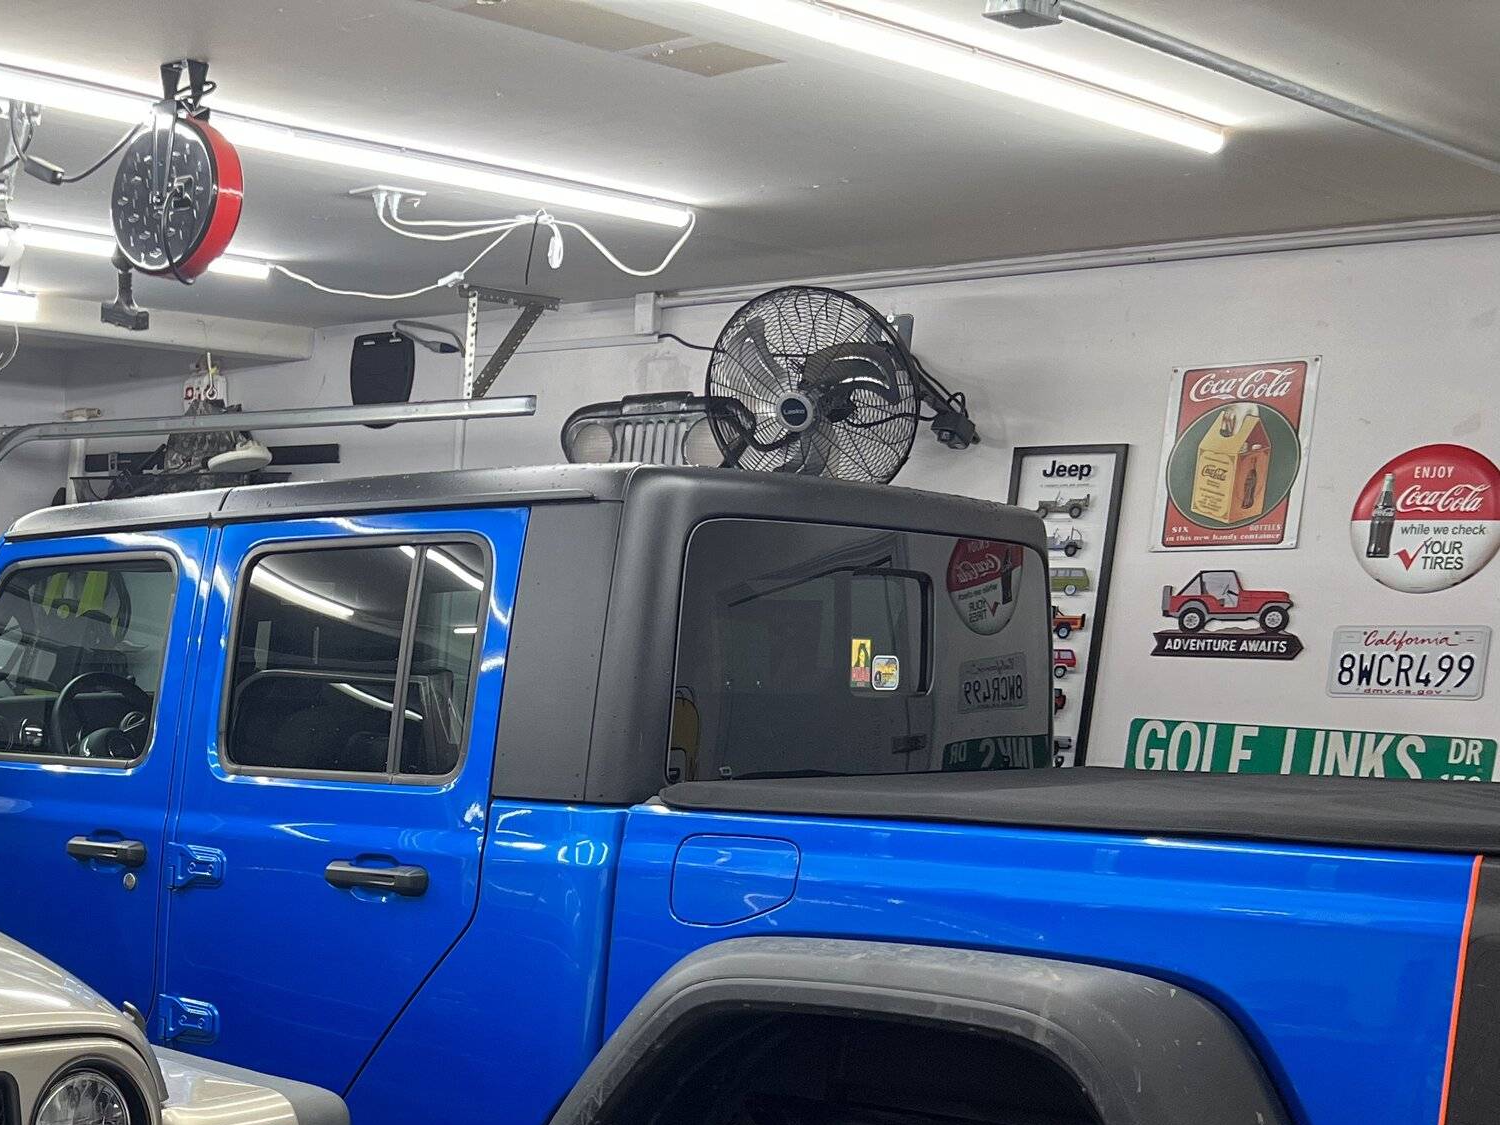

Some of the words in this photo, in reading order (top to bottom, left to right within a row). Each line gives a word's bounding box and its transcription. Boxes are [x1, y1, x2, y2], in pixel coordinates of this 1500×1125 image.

[1043, 460, 1092, 480] Jeep
[1414, 466, 1455, 479] ENJOY
[1400, 524, 1430, 535] while
[1433, 526, 1449, 535] we
[1451, 524, 1487, 535] check
[1423, 540, 1463, 555] YOUR
[1421, 556, 1464, 570] TIRES
[1164, 637, 1237, 652] ADVENTURE
[1239, 639, 1288, 653] AWAITS
[1364, 629, 1459, 651] California
[1338, 653, 1475, 688] 8WCR499
[1364, 687, 1443, 696] dmv.ca.gov
[1448, 738, 1484, 766] DR
